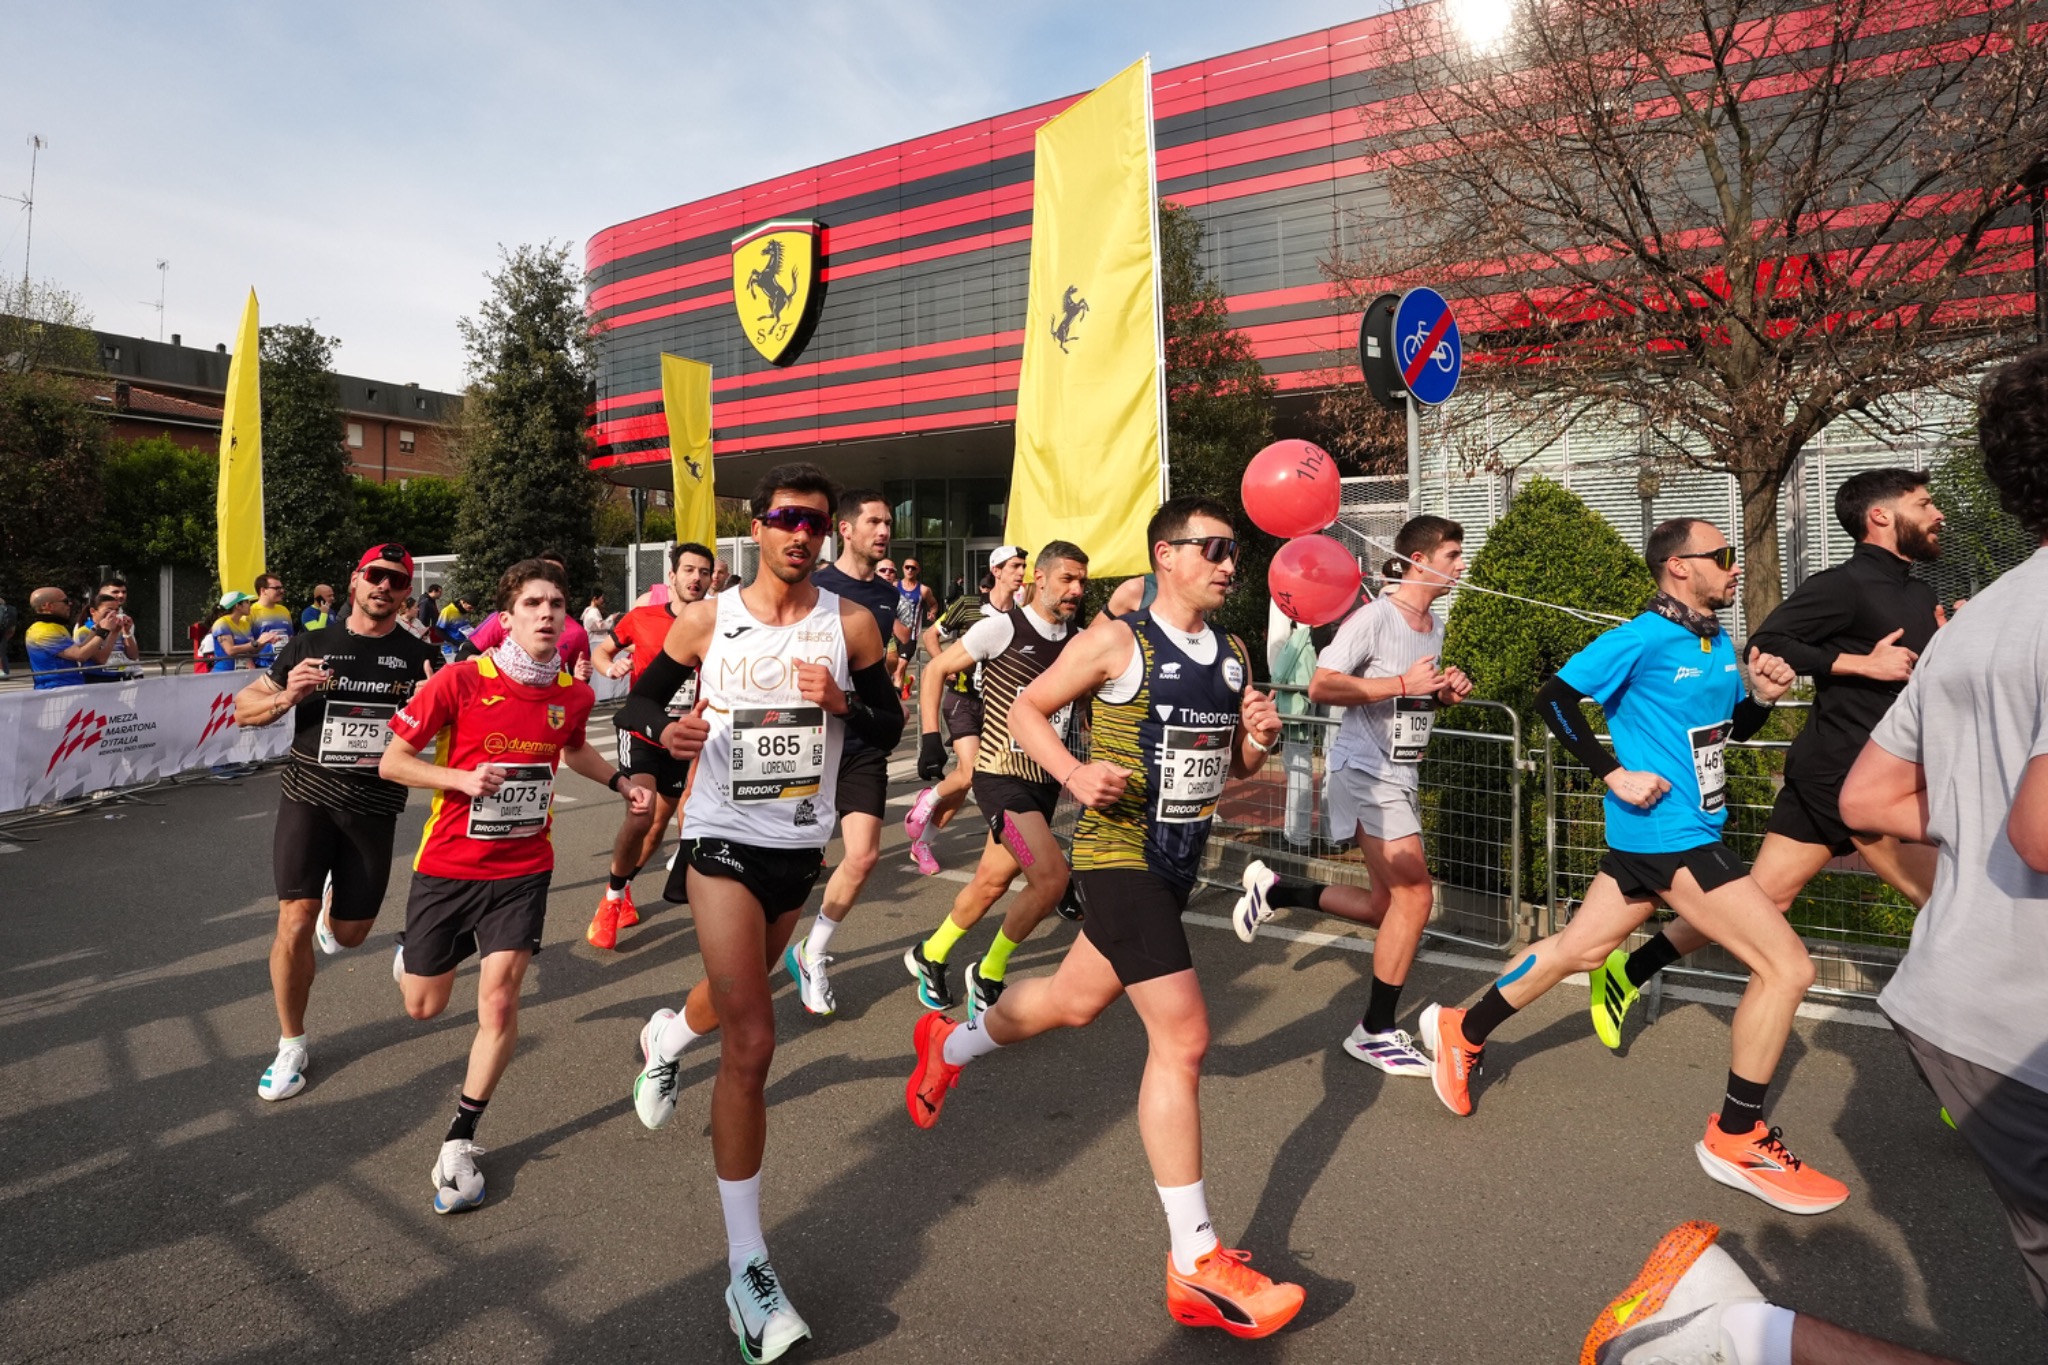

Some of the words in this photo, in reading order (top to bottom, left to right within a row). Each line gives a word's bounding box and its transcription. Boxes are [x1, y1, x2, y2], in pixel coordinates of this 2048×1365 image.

[1296, 445, 1324, 480] 1h2
[1278, 591, 1300, 619] 24
[108, 712, 139, 724] MEZZA
[1410, 716, 1428, 731] 109
[104, 721, 157, 736] MARATONA
[340, 722, 380, 738] 1275
[100, 735, 139, 748] D'ITALIA
[347, 739, 368, 749] MARCO
[508, 738, 557, 752] duemme
[757, 735, 801, 757] 865
[324, 754, 359, 762] BROOKS
[761, 759, 797, 775] LORENZO
[1183, 756, 1222, 778] 2163
[736, 784, 782, 796] BROOKS
[500, 805, 523, 817] DAVIDE
[1165, 804, 1202, 814] BROOKS
[473, 824, 512, 832] BROOKS
